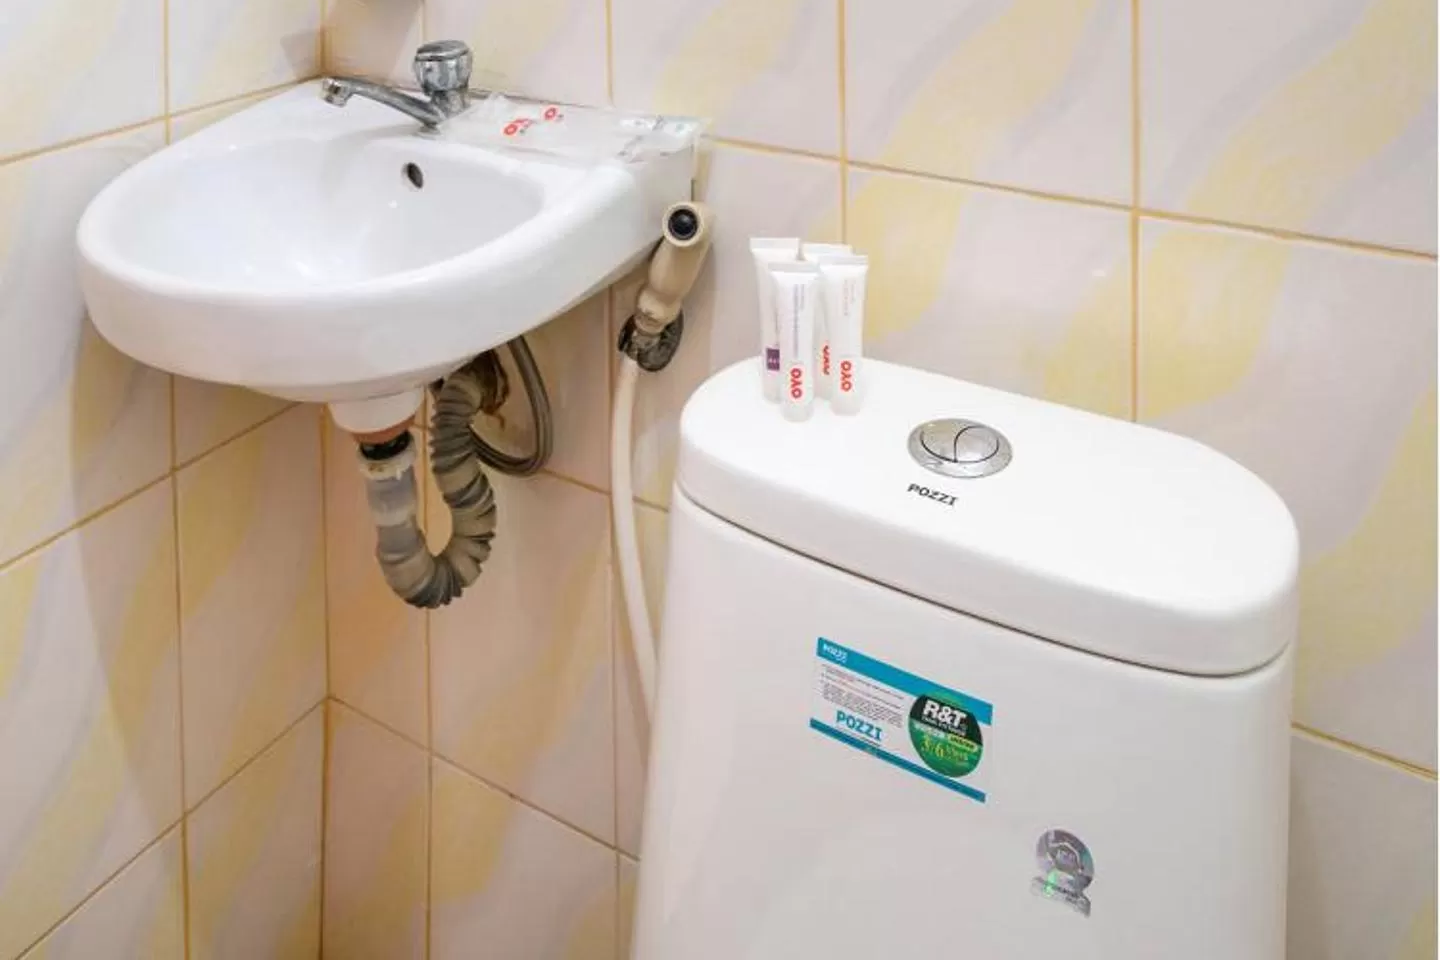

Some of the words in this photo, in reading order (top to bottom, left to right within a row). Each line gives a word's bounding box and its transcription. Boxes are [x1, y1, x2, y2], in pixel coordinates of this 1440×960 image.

[790, 368, 802, 399] OYO
[841, 361, 852, 392] OYO
[908, 483, 958, 505] POZZI
[837, 710, 882, 740] POZZI
[923, 700, 967, 727] R&T
